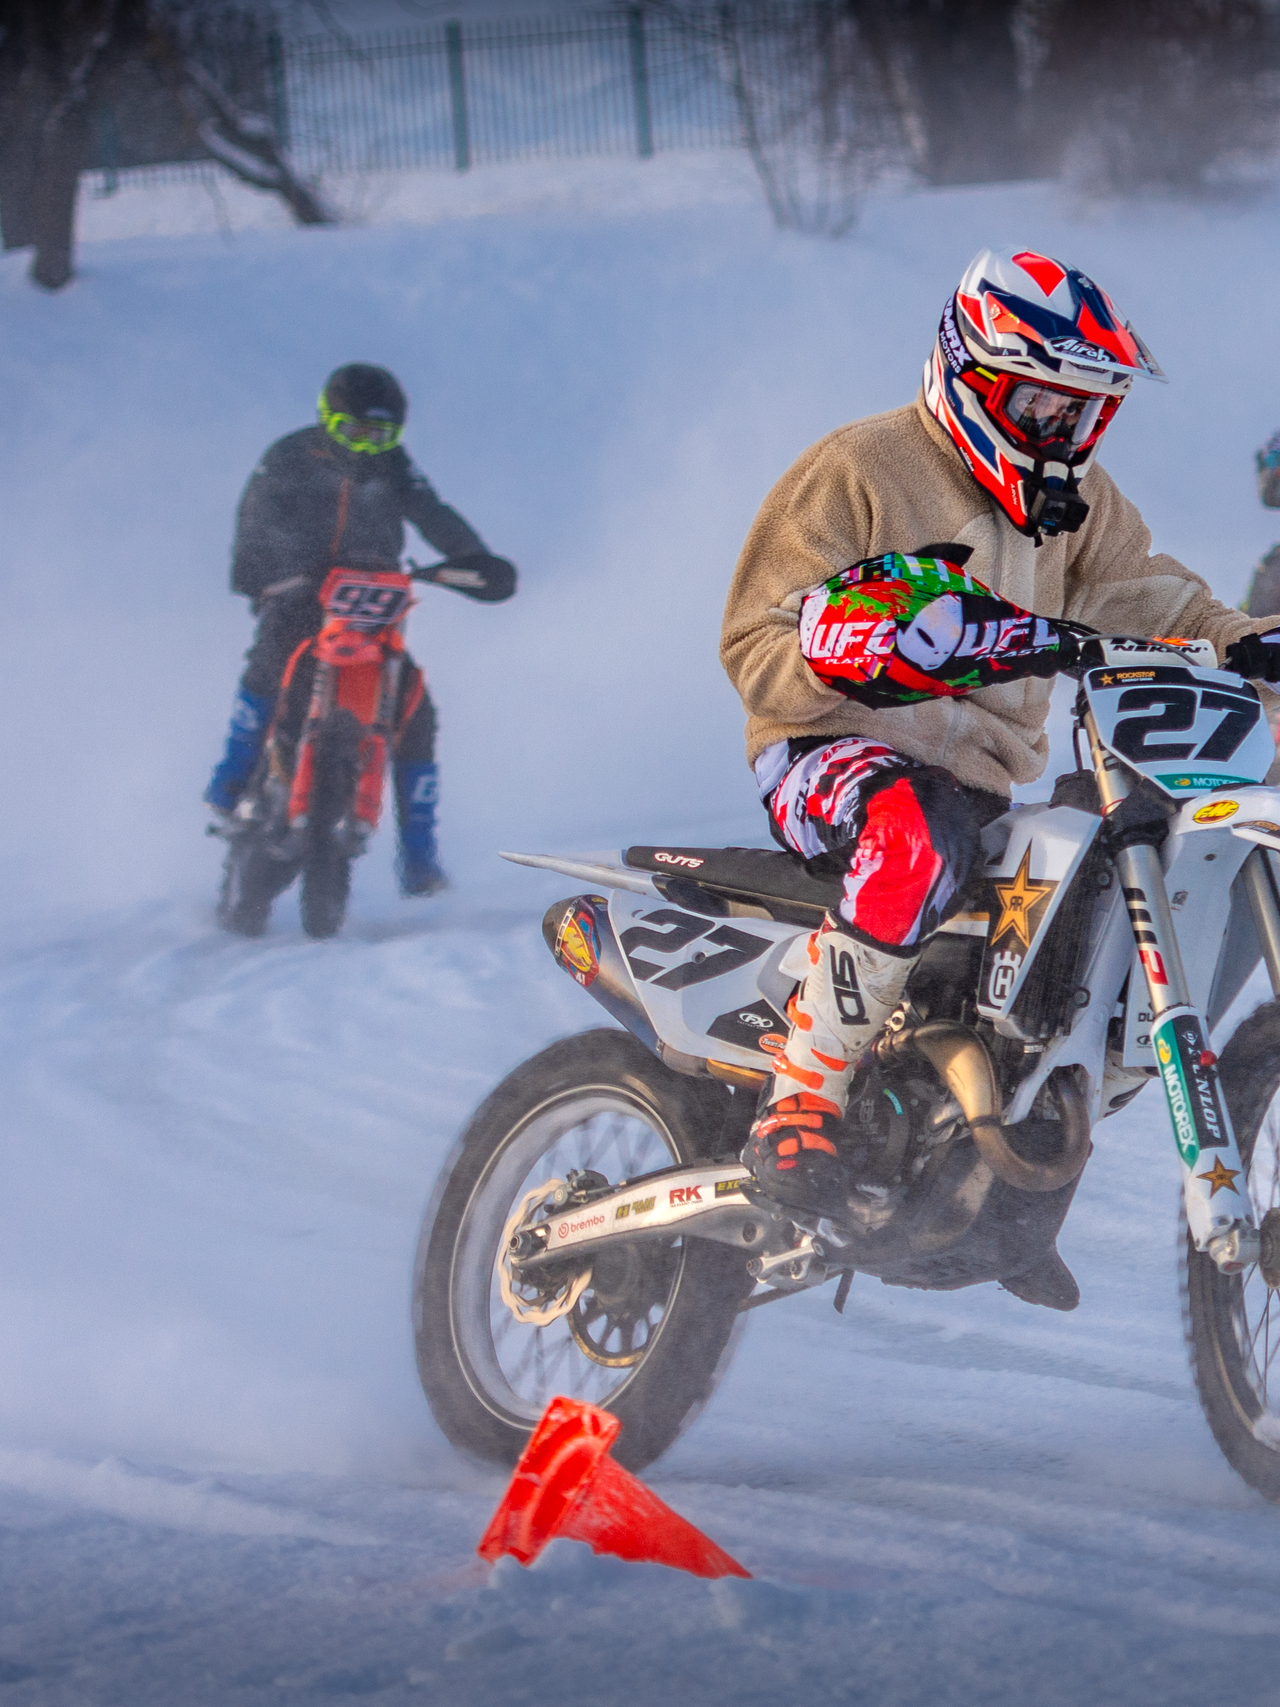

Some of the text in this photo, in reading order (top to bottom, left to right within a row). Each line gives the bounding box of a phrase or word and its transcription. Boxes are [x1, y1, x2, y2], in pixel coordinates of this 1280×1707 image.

[939, 331, 962, 374] MOTORS
[1052, 338, 1111, 362] Airoh
[1116, 670, 1156, 680] ROCKSTAR
[1112, 687, 1261, 764] 27
[654, 852, 703, 868] GUTS
[618, 908, 775, 992] 27
[1122, 887, 1169, 985] WP
[829, 944, 871, 1025] SIDI
[1163, 1064, 1195, 1151] MOTOREX
[669, 1185, 702, 1204] RK
[570, 1214, 606, 1233] brembo
